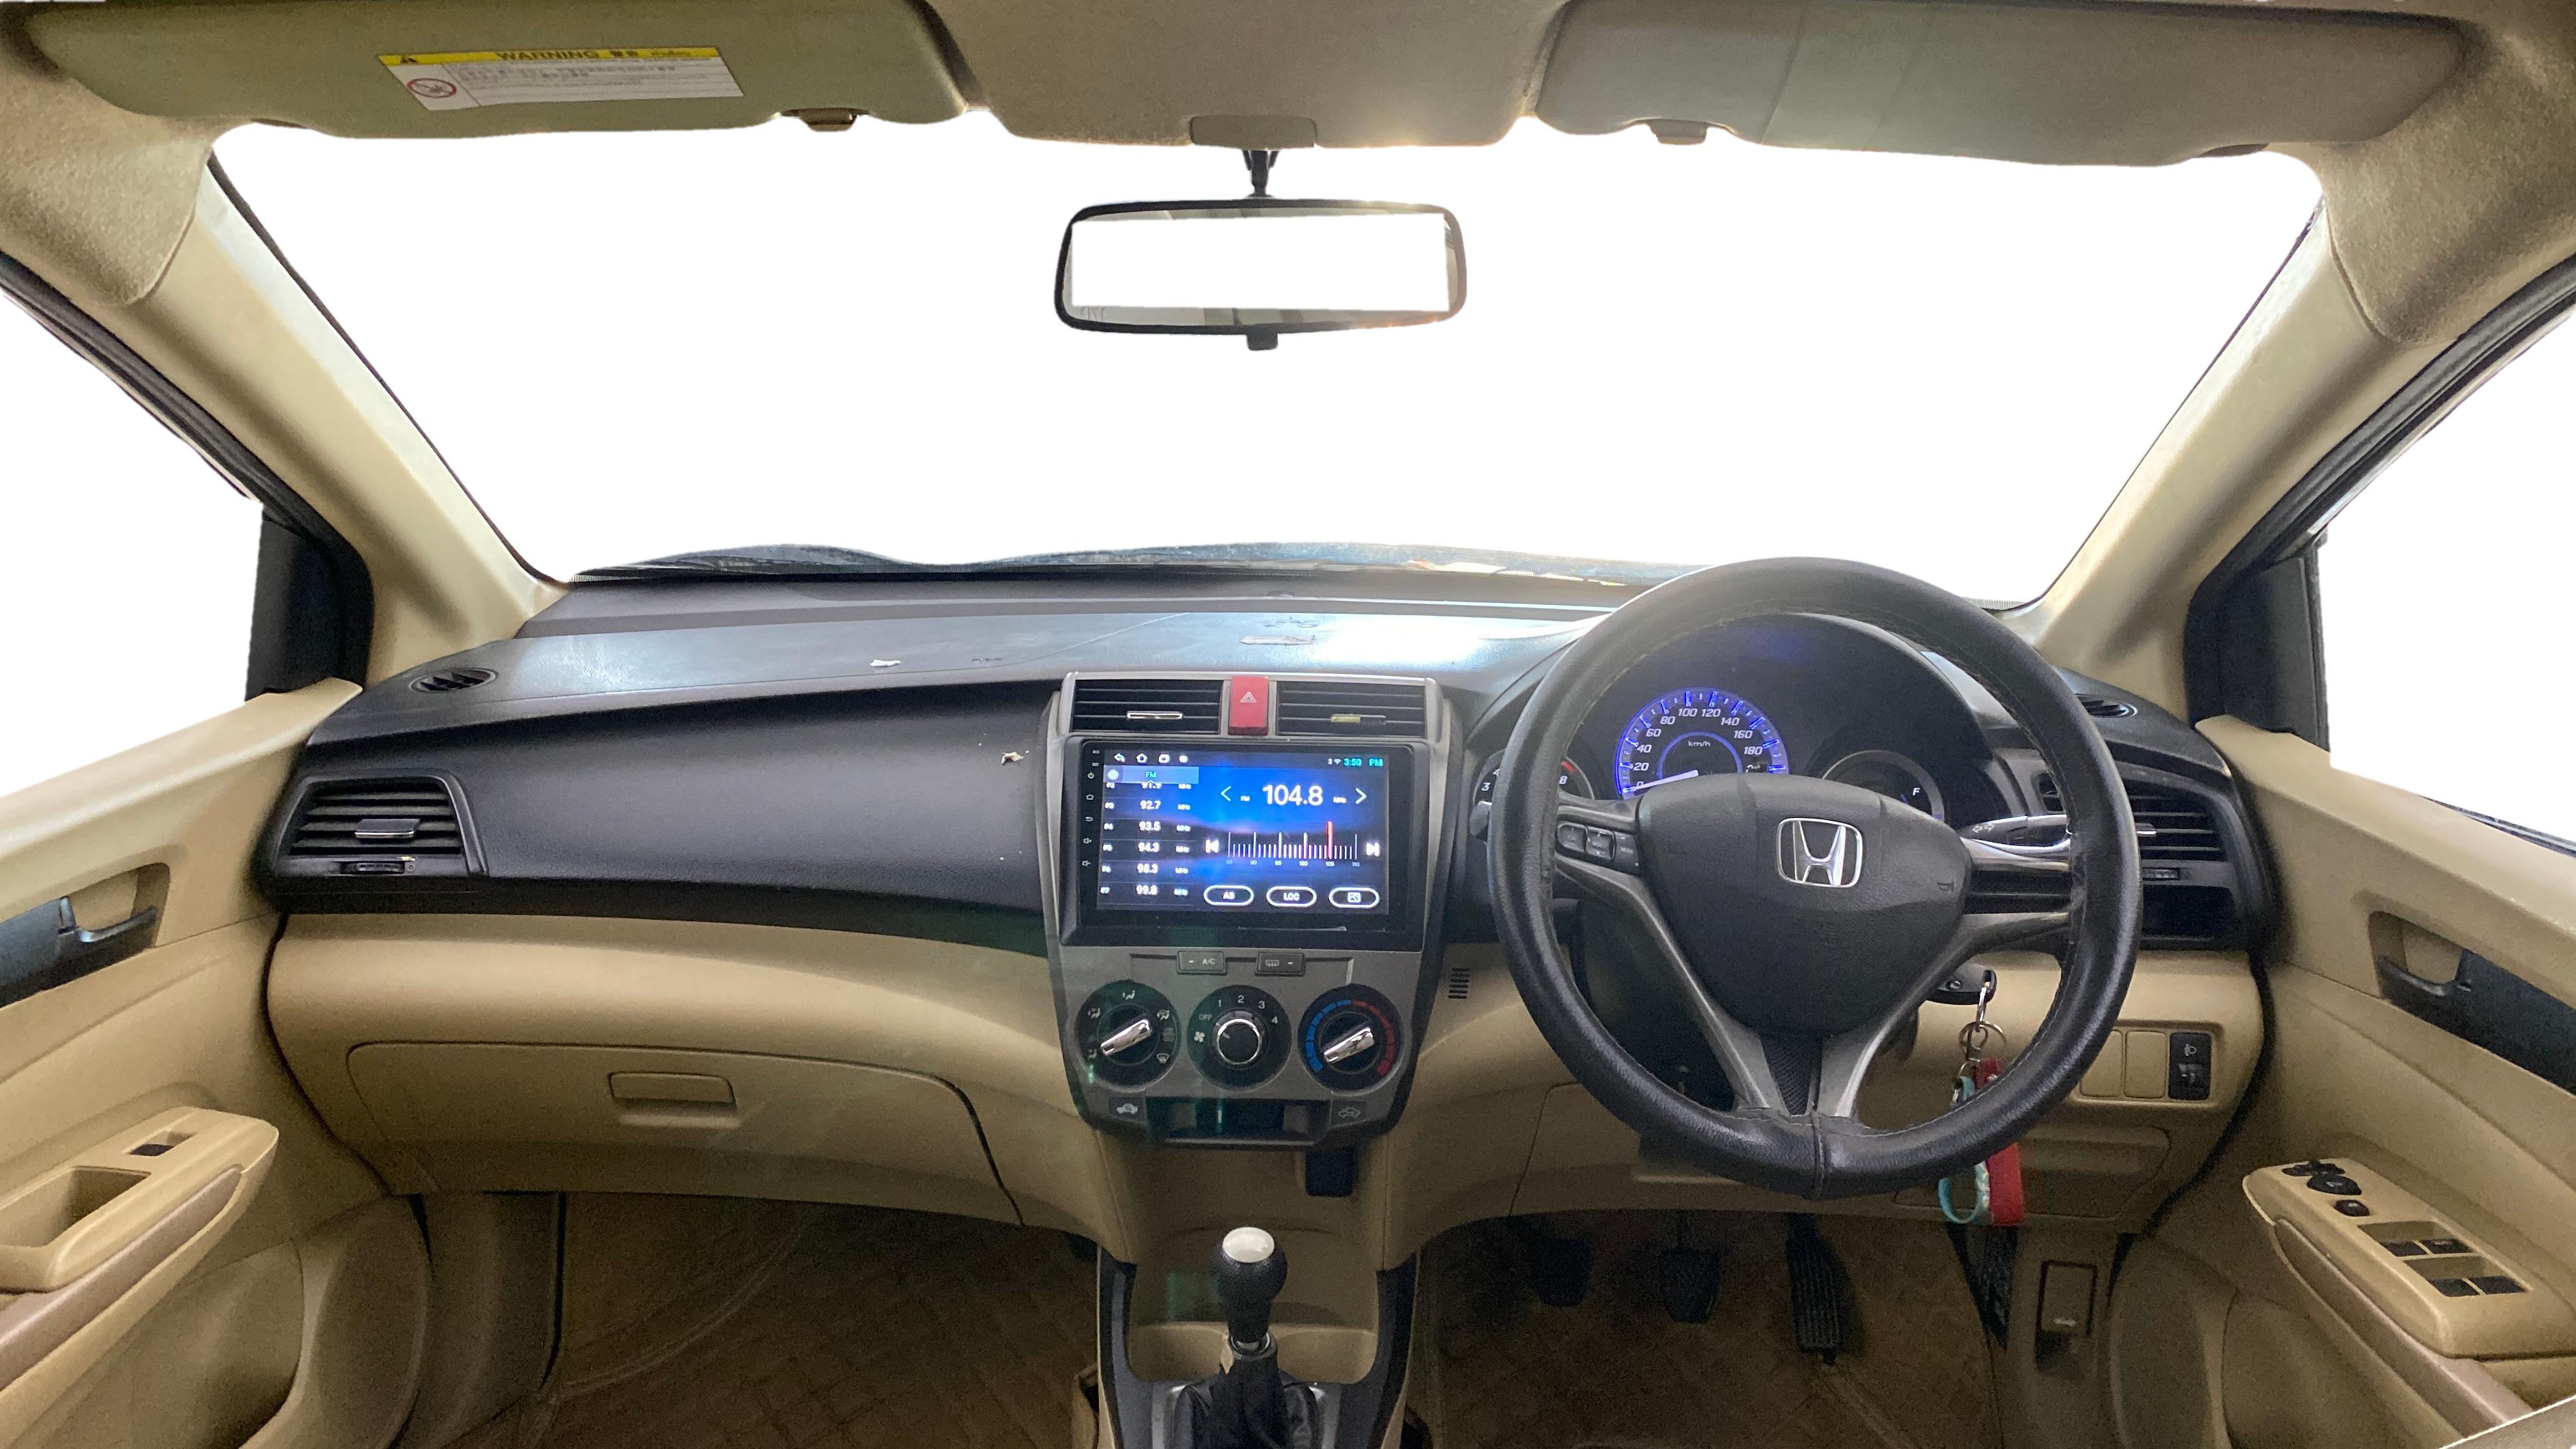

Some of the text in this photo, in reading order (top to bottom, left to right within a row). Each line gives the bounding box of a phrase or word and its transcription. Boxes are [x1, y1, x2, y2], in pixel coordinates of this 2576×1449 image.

[1678, 709, 1698, 717] 100
[1702, 709, 1721, 717] 120
[1660, 716, 1675, 724] 80
[1721, 717, 1740, 726] 140
[1646, 728, 1661, 737] 60
[1734, 730, 1752, 739] 160
[1637, 744, 1652, 753] 40
[1744, 746, 1763, 755] 180
[1369, 758, 1383, 767] PM
[1633, 762, 1649, 770] 20
[1559, 776, 1568, 785] 8
[1482, 782, 1491, 791] 3
[1262, 785, 1323, 806] 104.8
[1912, 787, 1920, 796] F
[1140, 800, 1162, 809] 92.7
[1138, 821, 1161, 831] 93.5
[1138, 842, 1160, 852] 94.3
[1137, 863, 1158, 873] 98.3
[1284, 893, 1300, 901] LOC
[1218, 999, 1222, 1008] 1
[1238, 995, 1245, 1004] 2
[1258, 1000, 1265, 1009] 3
[1271, 1016, 1278, 1024] 4
